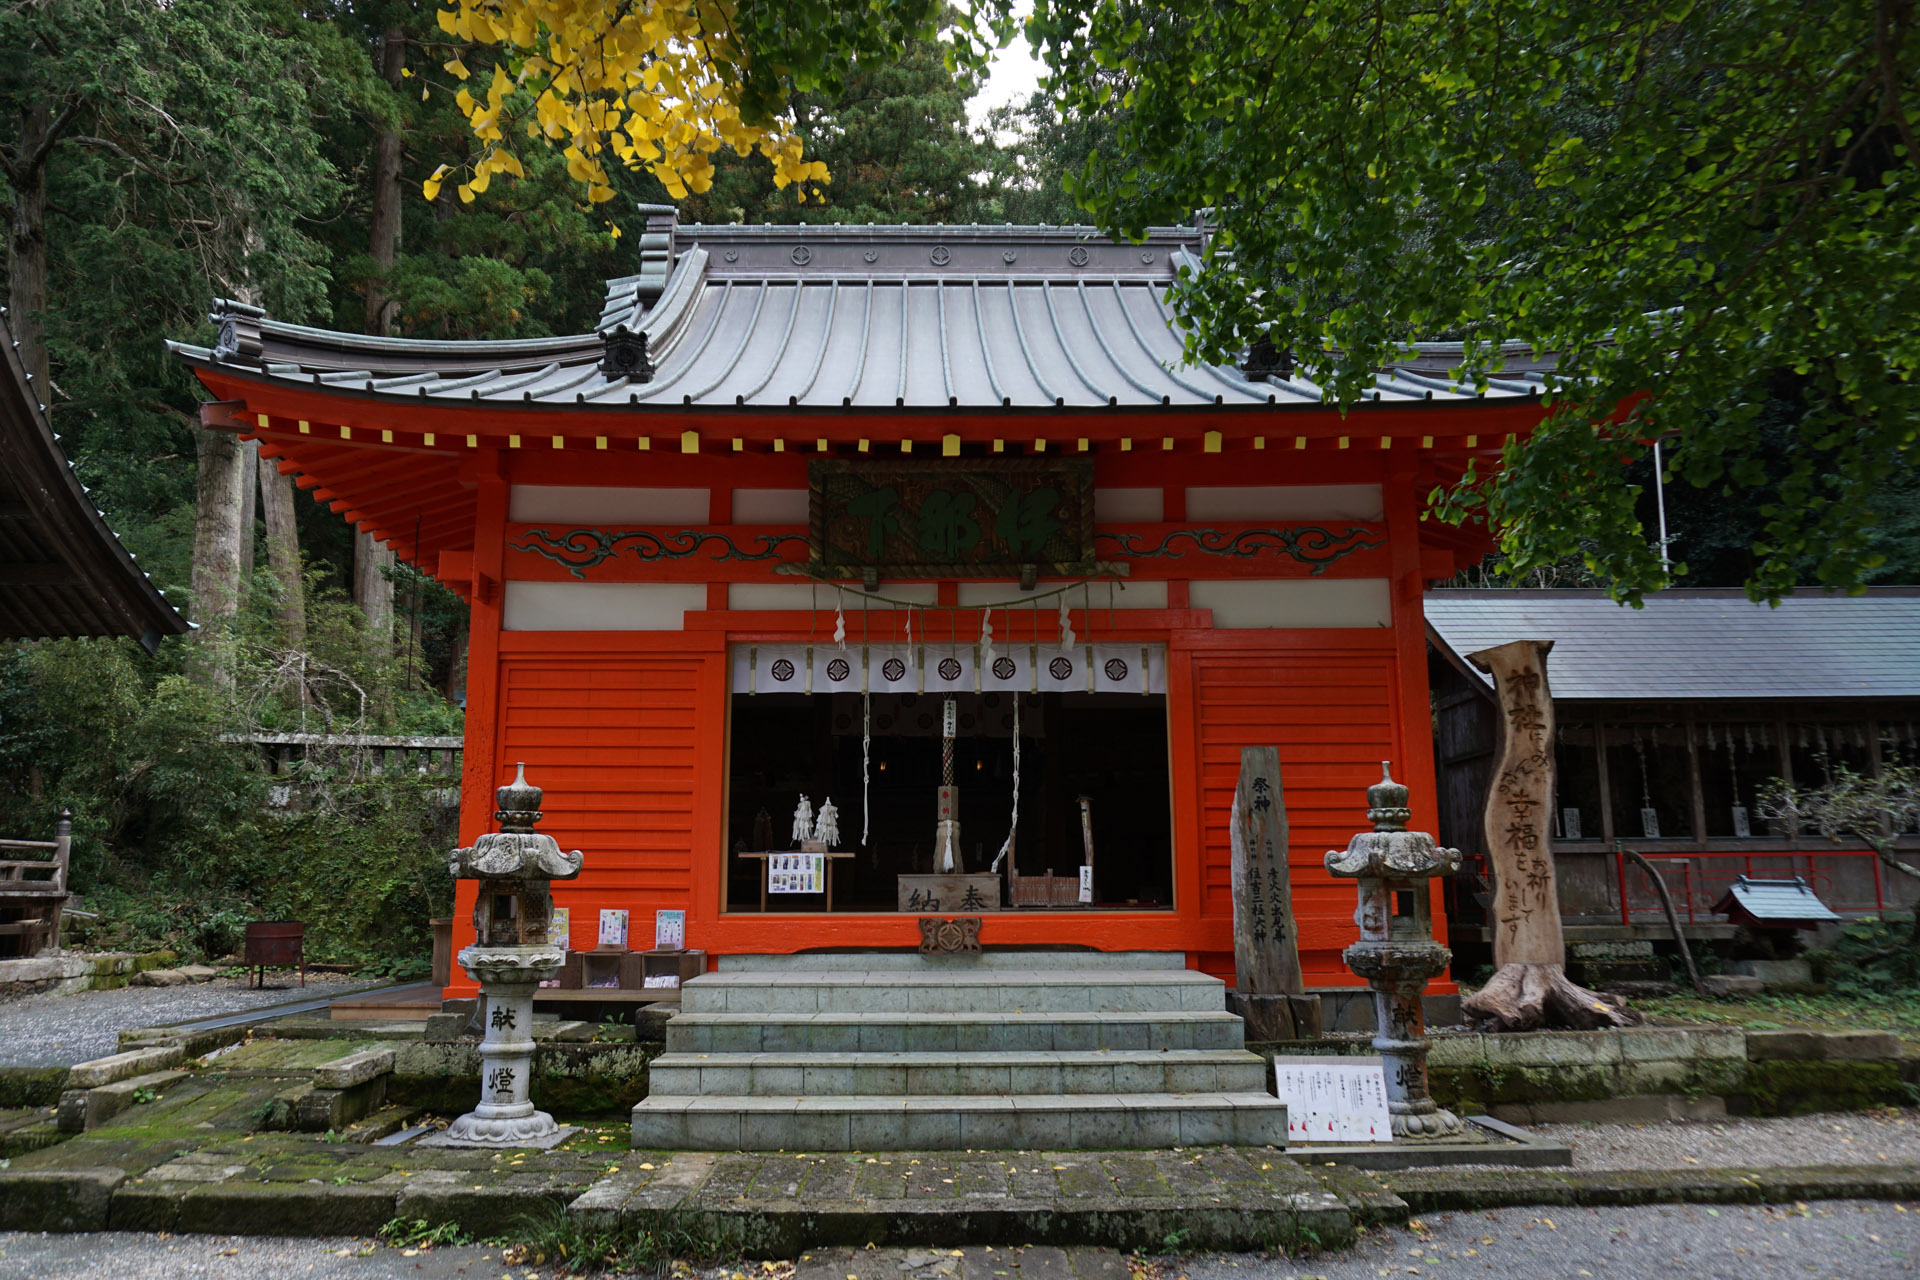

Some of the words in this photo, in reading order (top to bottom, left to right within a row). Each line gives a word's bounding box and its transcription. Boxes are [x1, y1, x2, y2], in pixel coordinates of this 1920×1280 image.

[1252, 777, 1271, 813] 祭神
[908, 884, 988, 912] 奉納
[1248, 867, 1267, 943] 住吉三柱大神
